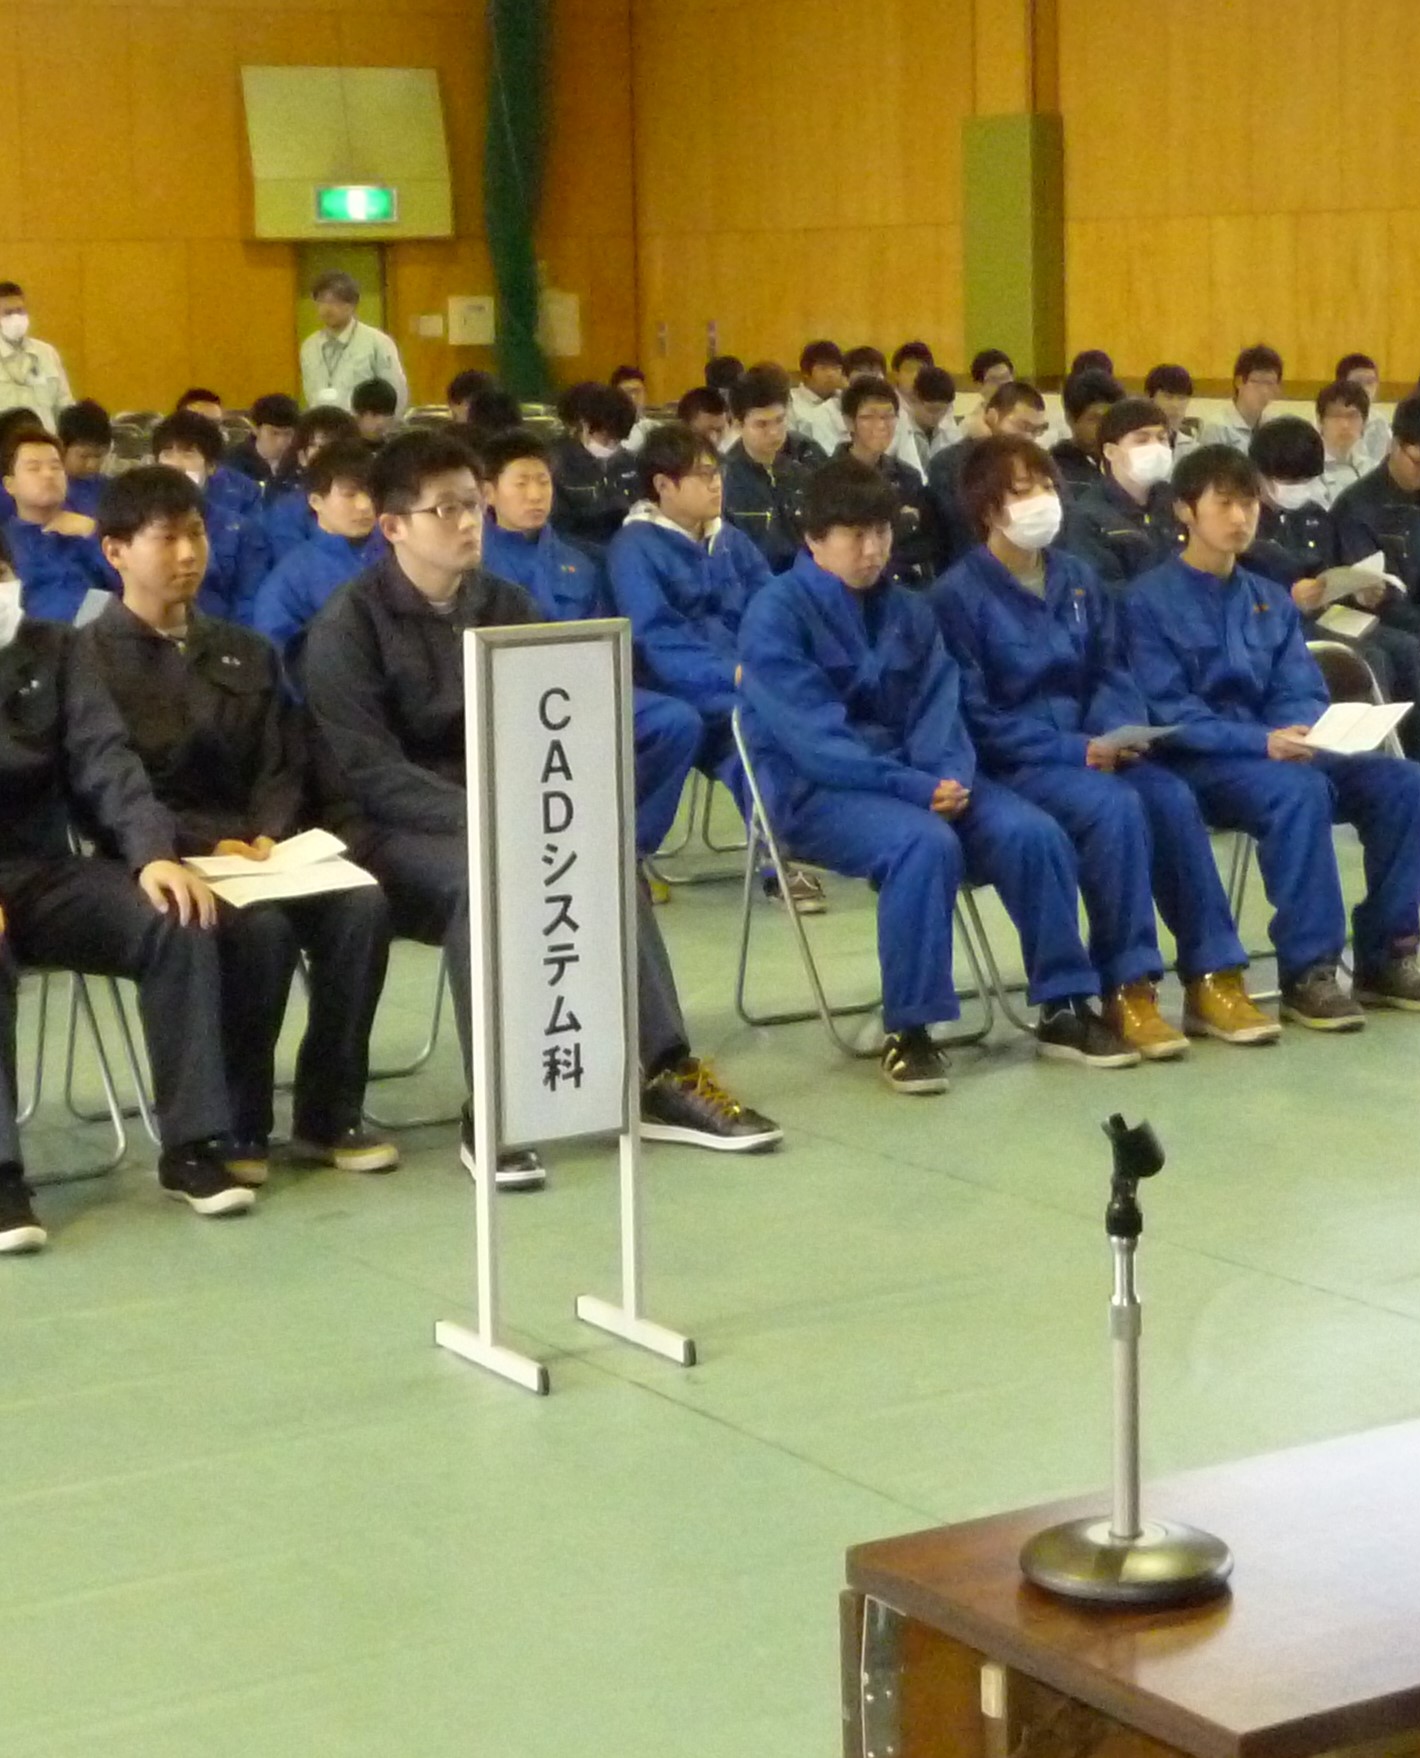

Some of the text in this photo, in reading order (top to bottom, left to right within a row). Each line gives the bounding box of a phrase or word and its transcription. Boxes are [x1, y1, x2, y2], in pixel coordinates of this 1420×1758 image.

[538, 688, 584, 1092] CADシステム科
